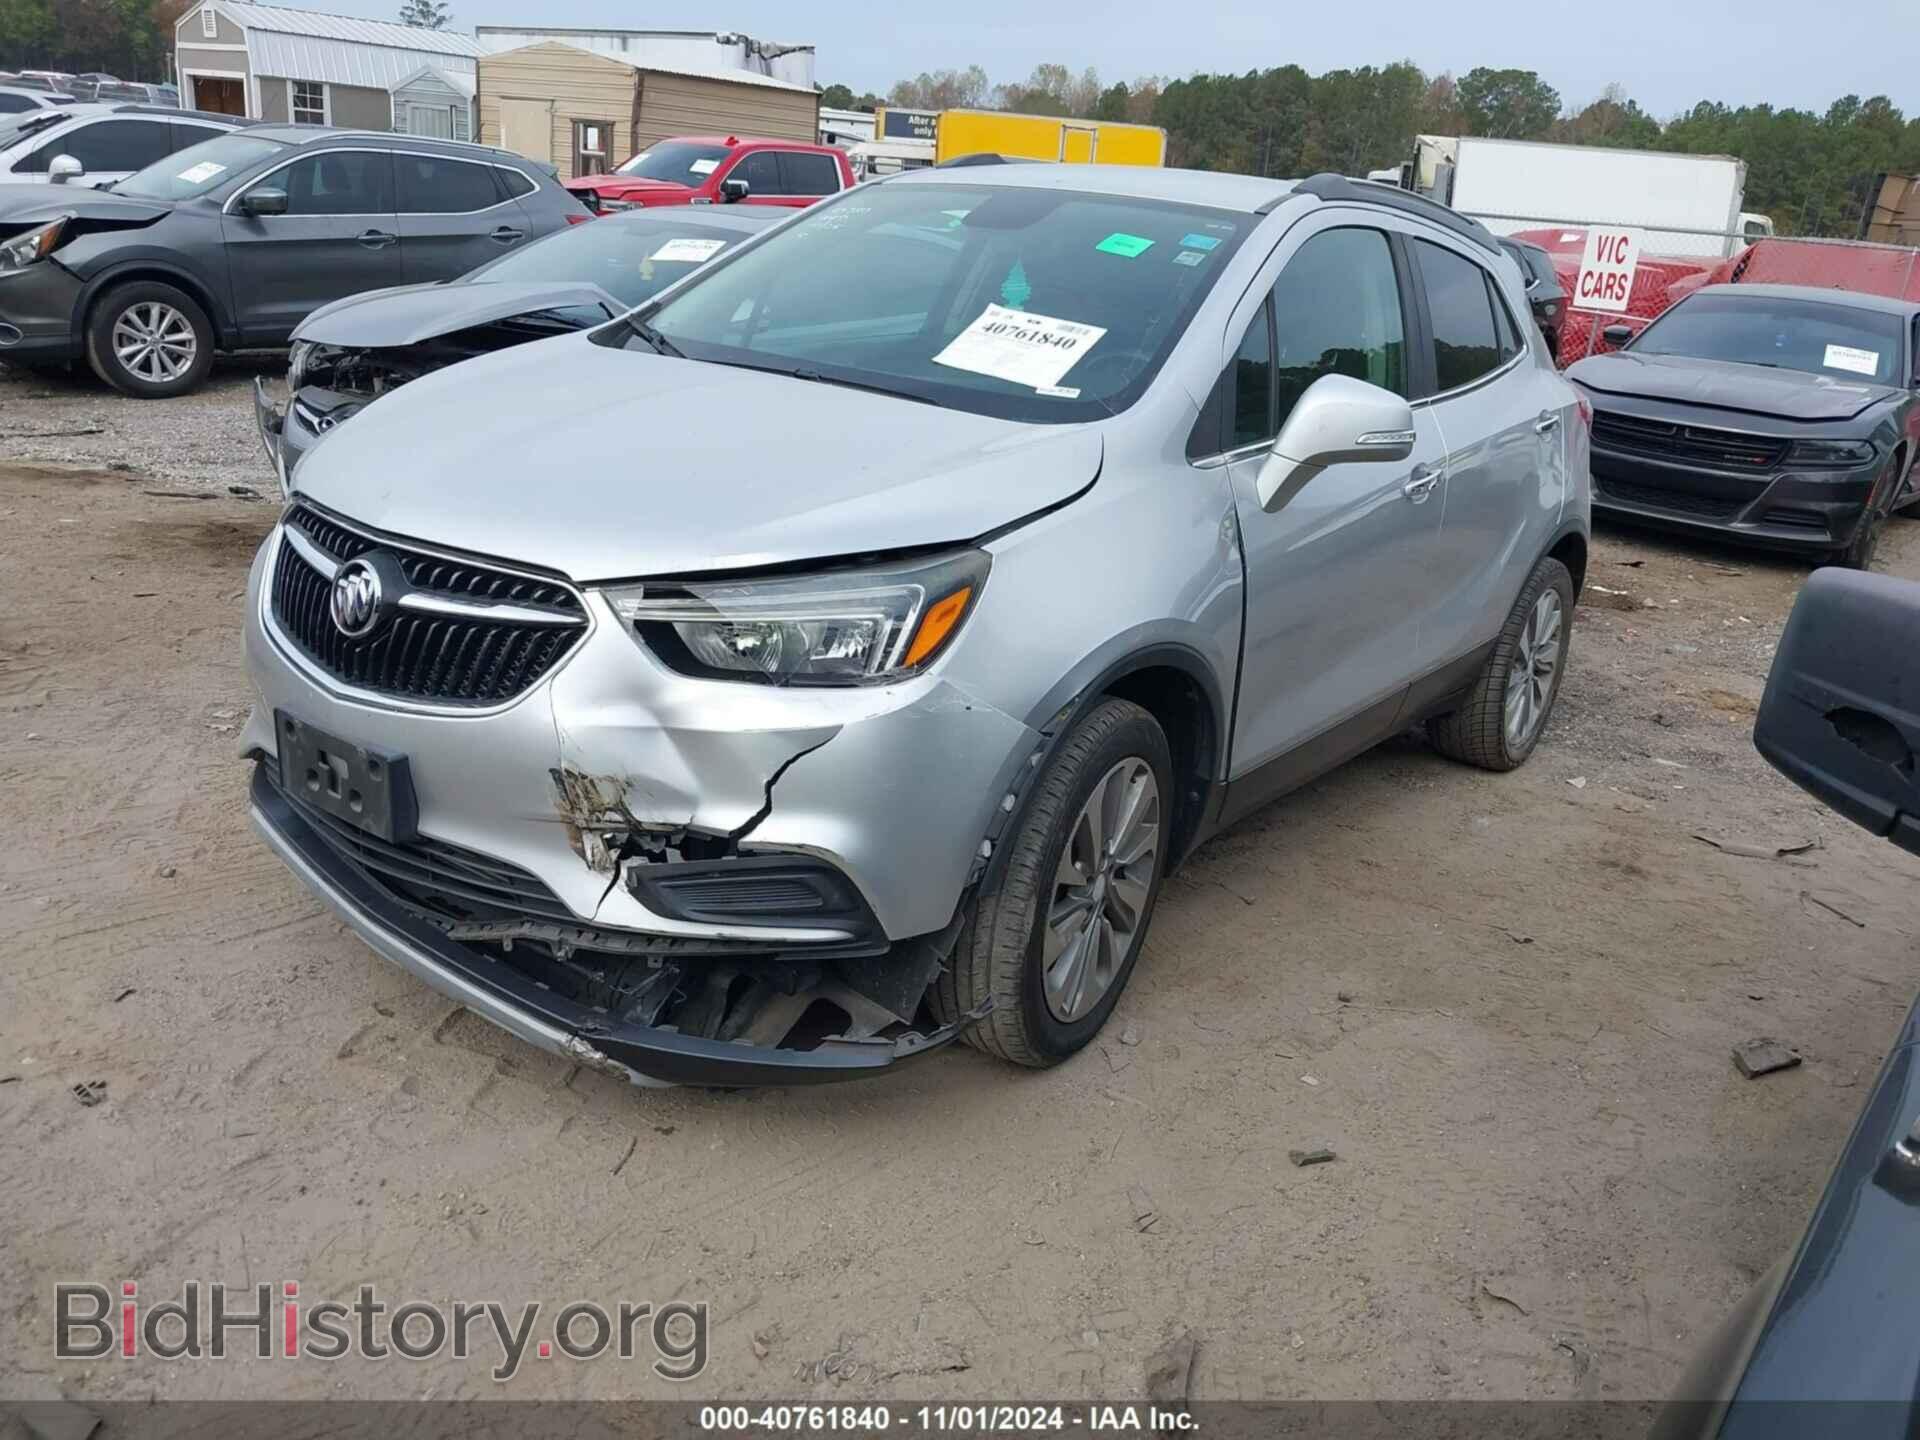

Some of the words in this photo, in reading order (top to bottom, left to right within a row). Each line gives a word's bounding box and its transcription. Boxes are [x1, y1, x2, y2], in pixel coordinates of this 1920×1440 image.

[1597, 235, 1628, 264] VIC
[1581, 270, 1628, 300] CARS
[982, 321, 1076, 350] 40761840
